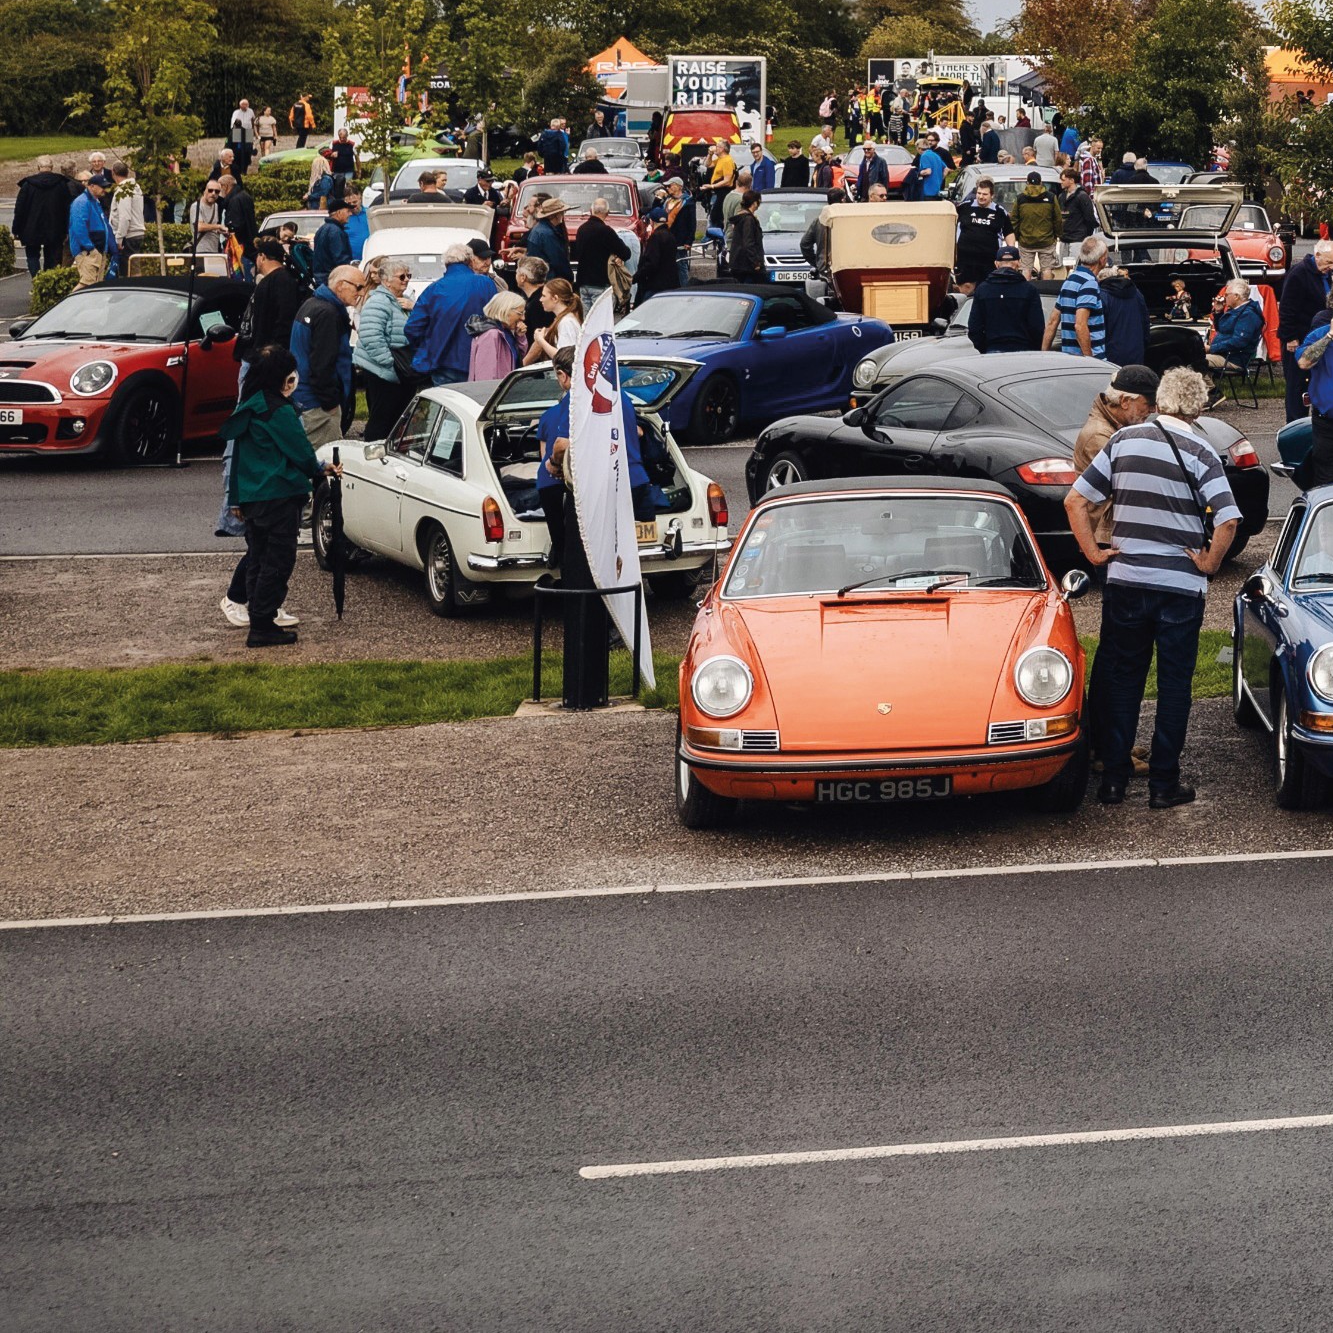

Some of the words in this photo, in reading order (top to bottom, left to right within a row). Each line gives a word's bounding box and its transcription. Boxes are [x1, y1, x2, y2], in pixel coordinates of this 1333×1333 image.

[677, 61, 727, 75] RAISE
[675, 76, 727, 90] YOUR
[676, 92, 726, 106] RIDE
[971, 218, 991, 226] INEOS
[587, 362, 599, 379] Early
[817, 781, 871, 802] HGC
[879, 777, 951, 800] 985J
